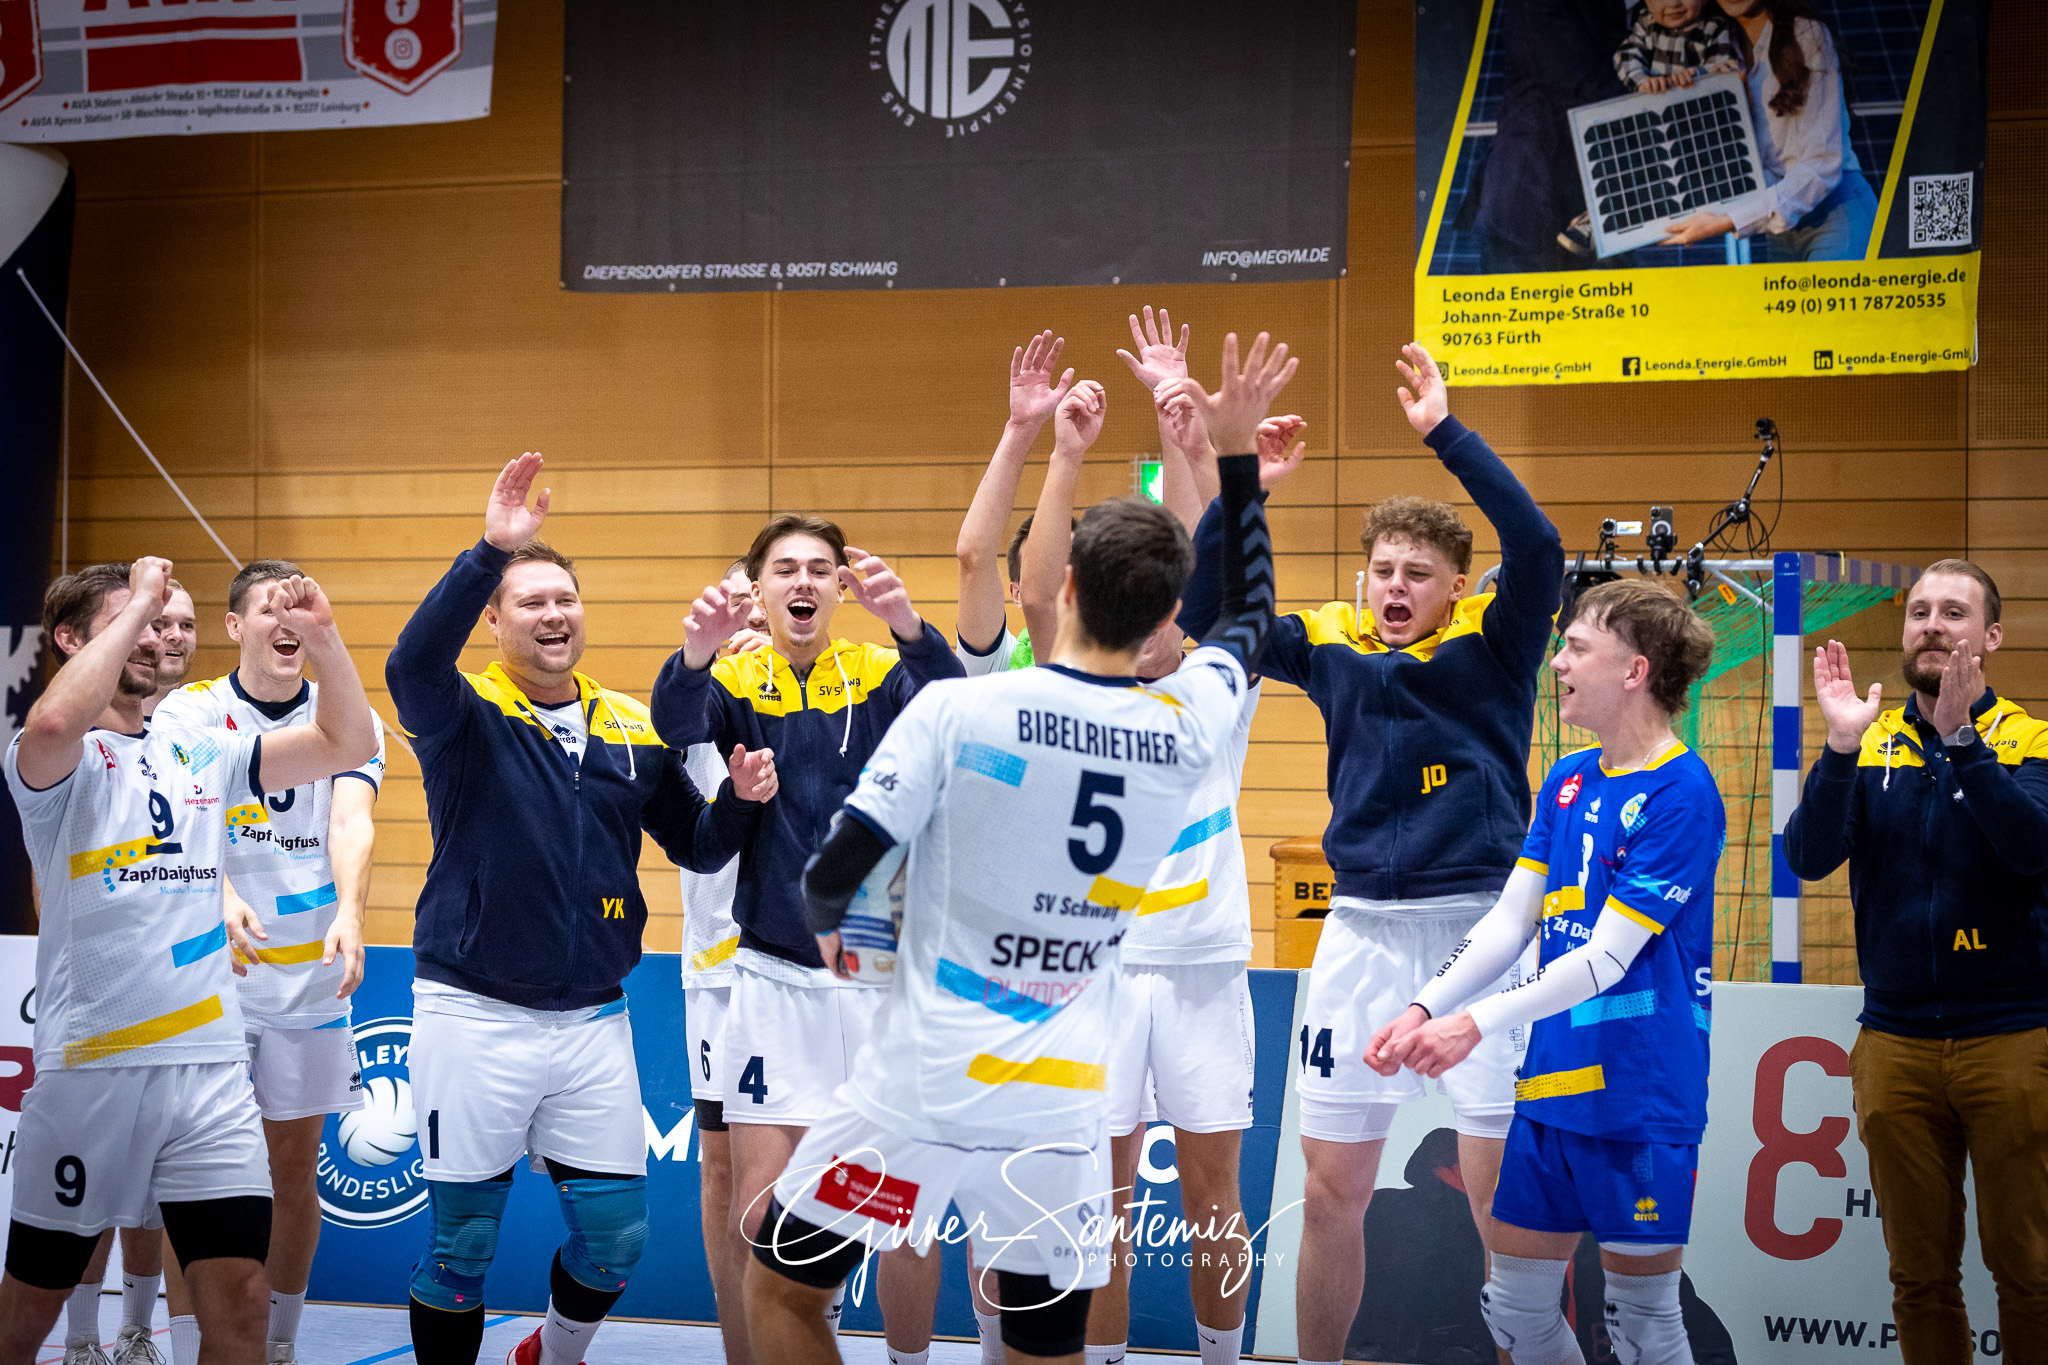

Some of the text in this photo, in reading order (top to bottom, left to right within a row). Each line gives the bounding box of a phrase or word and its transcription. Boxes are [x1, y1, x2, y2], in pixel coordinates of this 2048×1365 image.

[946, 0, 1032, 138] YSIOTHERAPIE
[71, 97, 92, 110] AVIA
[94, 96, 122, 109] Station
[243, 87, 264, 100] Lauf
[286, 87, 320, 101] Pegnitz
[30, 115, 53, 128] AVIA
[54, 115, 82, 128] Xpress
[84, 113, 113, 125] Station
[1201, 246, 1332, 268] INFO@MEGYM.DE
[583, 260, 899, 281] DIEPERSDORFER STRASSE 8, 90571 SCHWAIG
[1763, 267, 1967, 292] info@leonda-energie.de
[1442, 281, 1634, 303] Leonda Energie GmbH
[1764, 292, 1947, 315] +49 (0) 911 78720535
[1441, 303, 1650, 325] Johann-Zumpe-Straße 10
[1442, 329, 1542, 346] 90763 Fürth
[1645, 355, 1788, 374] Leonda.Energie.GmbH
[1838, 347, 1969, 367] Leonda-Energie-Gmb
[1453, 361, 1592, 378] Leonda.Energie.GmbH
[759, 693, 782, 702] errea
[819, 685, 833, 696] SV
[1017, 708, 1179, 766] BIBELRIETHER
[1421, 764, 1448, 795] JD
[148, 789, 175, 840] 9
[1067, 769, 1126, 876] 5
[602, 897, 625, 920] YK
[1033, 892, 1057, 914] SV
[1953, 928, 1988, 951] AL
[990, 933, 1104, 973] SPECK
[700, 1038, 712, 1083] 6
[1299, 1024, 1335, 1079] 14
[738, 1055, 768, 1105] 4
[426, 1109, 440, 1160] 1
[54, 1155, 87, 1208] 9
[1633, 1213, 1660, 1221] errea
